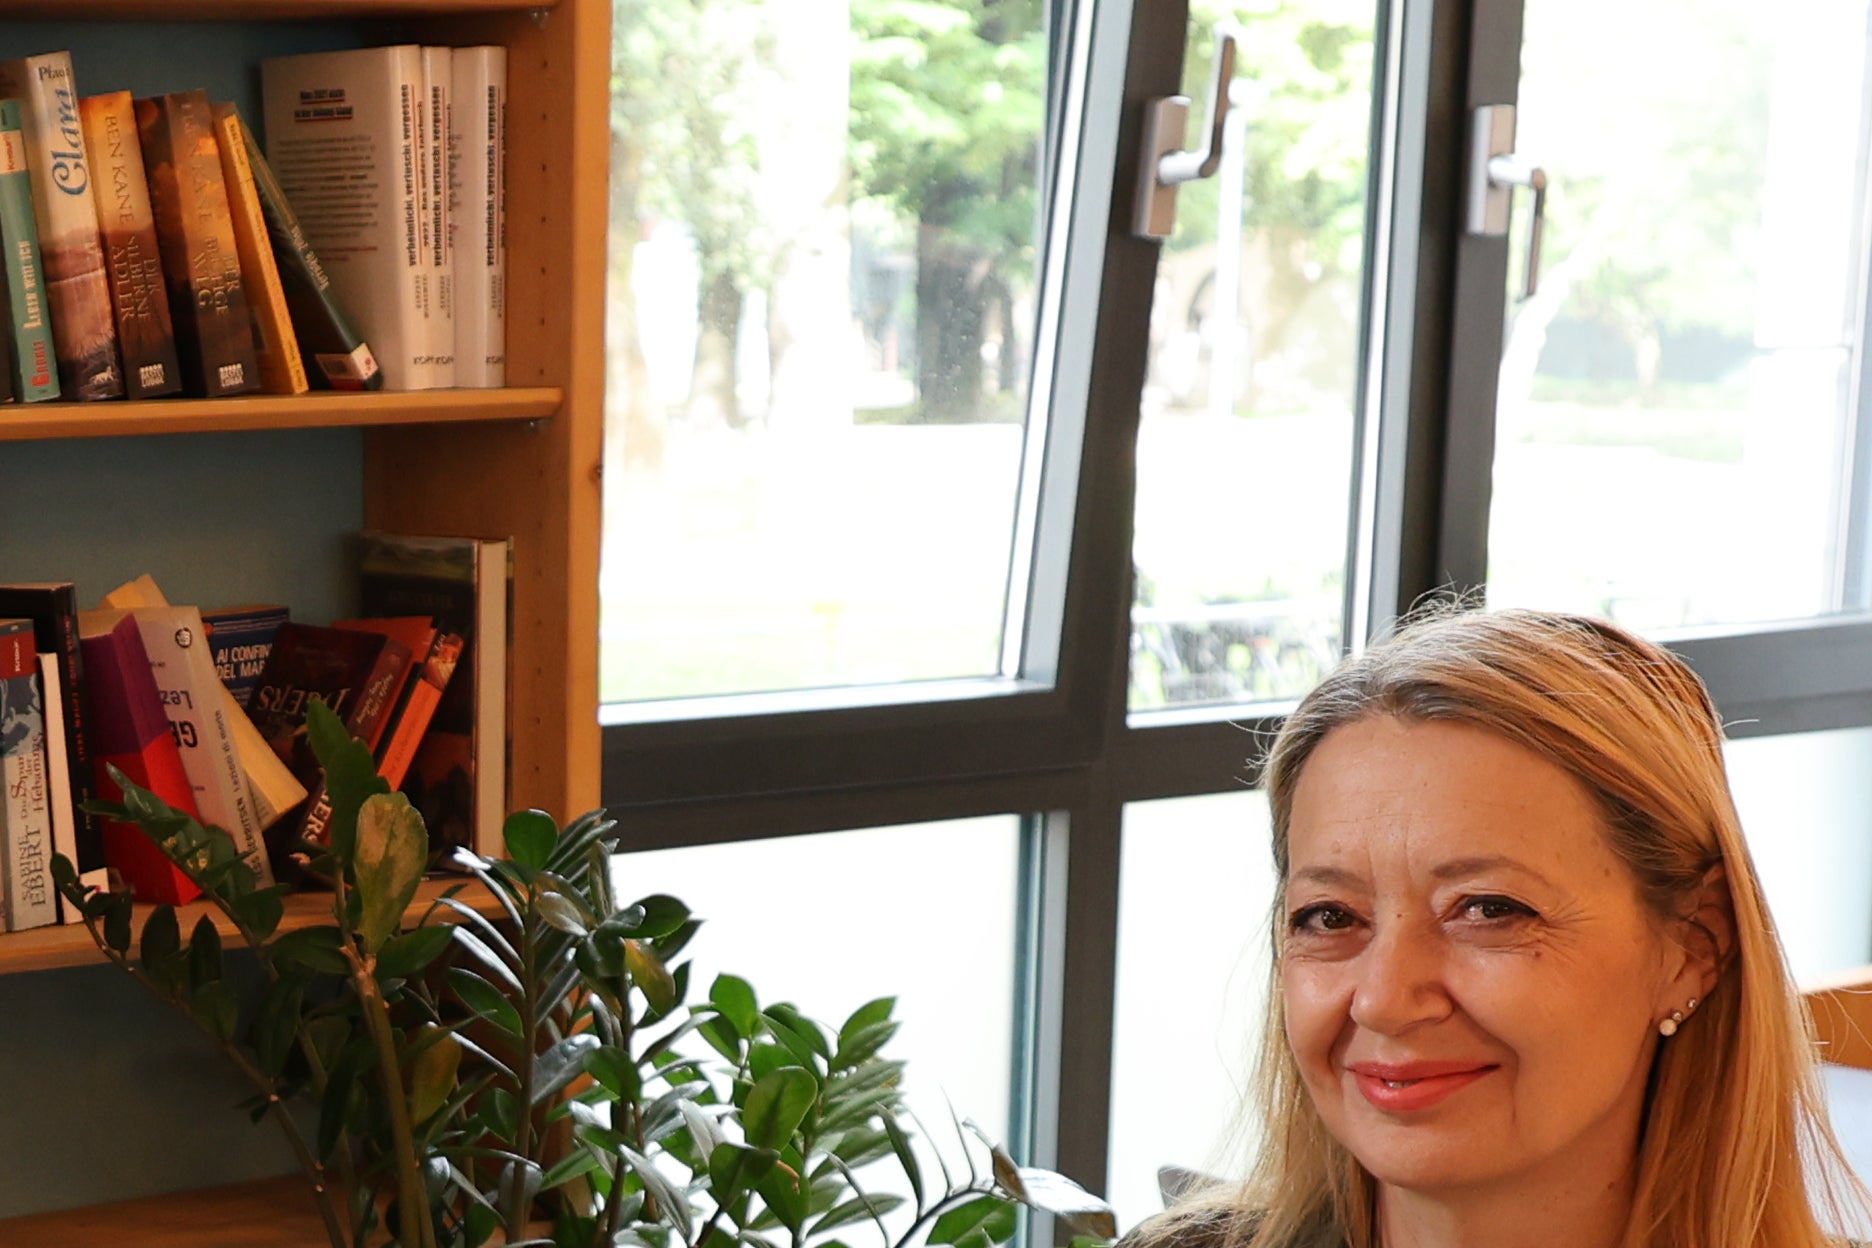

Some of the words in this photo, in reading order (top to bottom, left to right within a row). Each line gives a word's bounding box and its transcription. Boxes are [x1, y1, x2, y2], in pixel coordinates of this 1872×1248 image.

[104, 116, 124, 158] BEN
[400, 84, 412, 140] vergessen
[431, 85, 441, 141] vergessen
[486, 85, 496, 141] vergessen
[112, 165, 135, 225] KANE
[111, 245, 136, 322] ADLER
[128, 235, 151, 320] SILBERNE
[143, 257, 159, 298] DER
[193, 250, 214, 307] WEG
[222, 255, 241, 292] DER
[231, 643, 273, 662] CONFIN
[214, 710, 228, 742] morte
[222, 742, 231, 754] di
[10, 752, 28, 800] Spur
[30, 734, 45, 813] Hebamme
[224, 753, 240, 793] Lezioni
[18, 829, 34, 902] SABINE
[26, 827, 46, 907] EBERT
